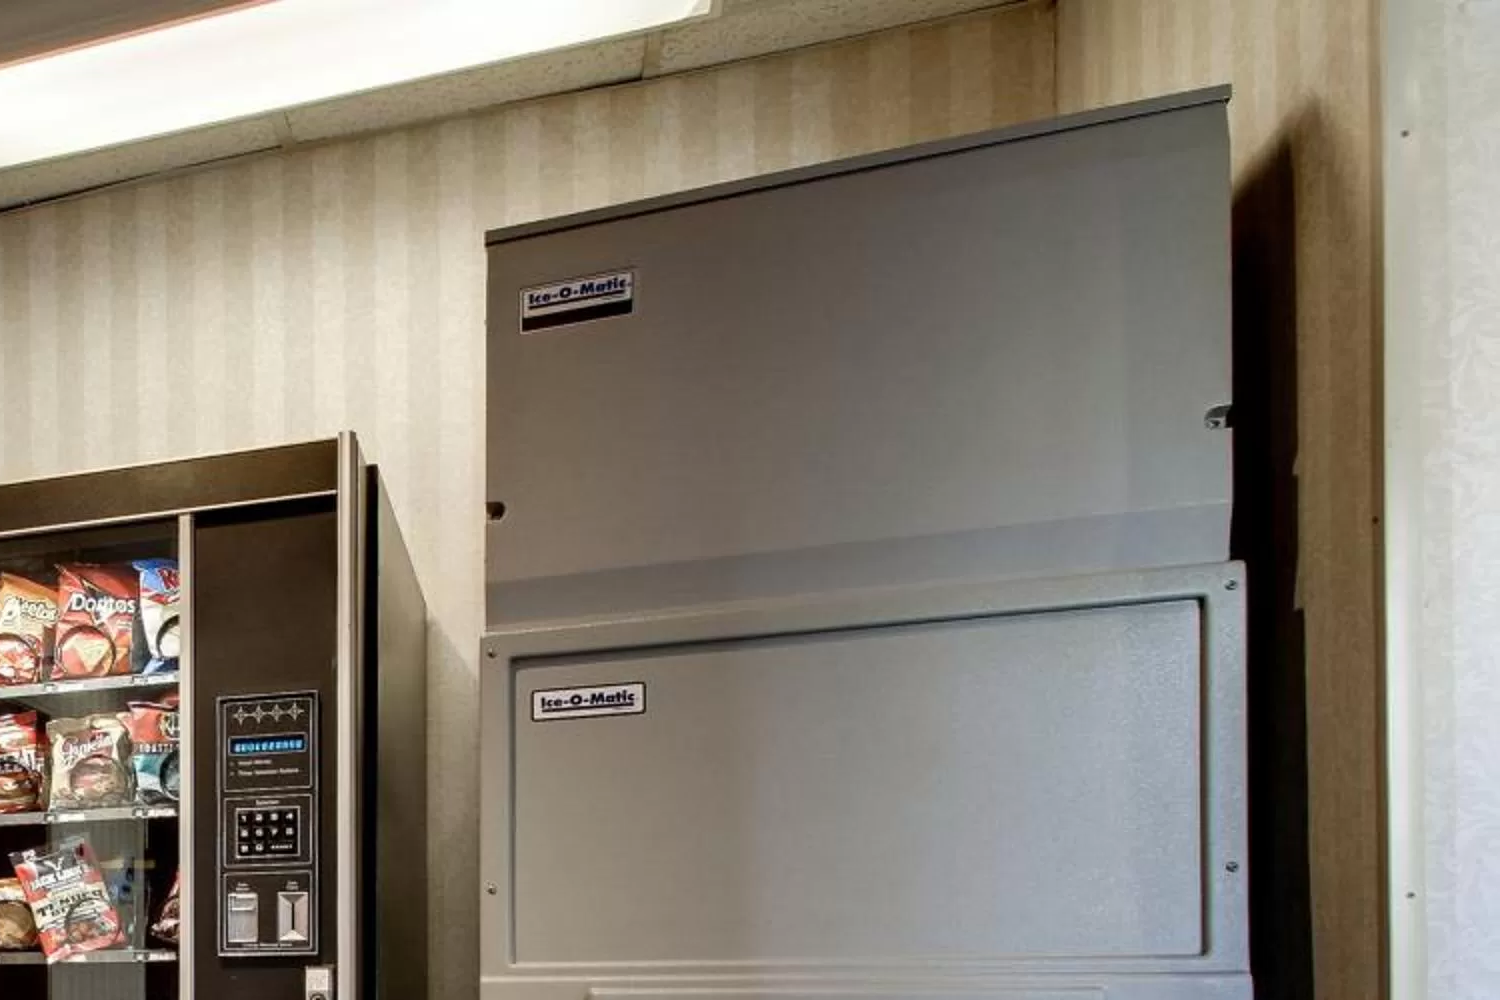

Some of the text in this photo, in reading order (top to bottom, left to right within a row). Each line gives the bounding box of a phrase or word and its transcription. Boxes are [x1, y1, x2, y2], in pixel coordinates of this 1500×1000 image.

[528, 277, 626, 305] Ice-O-Matic
[69, 591, 136, 616] Doritos
[540, 689, 635, 709] Ice-O-Matic
